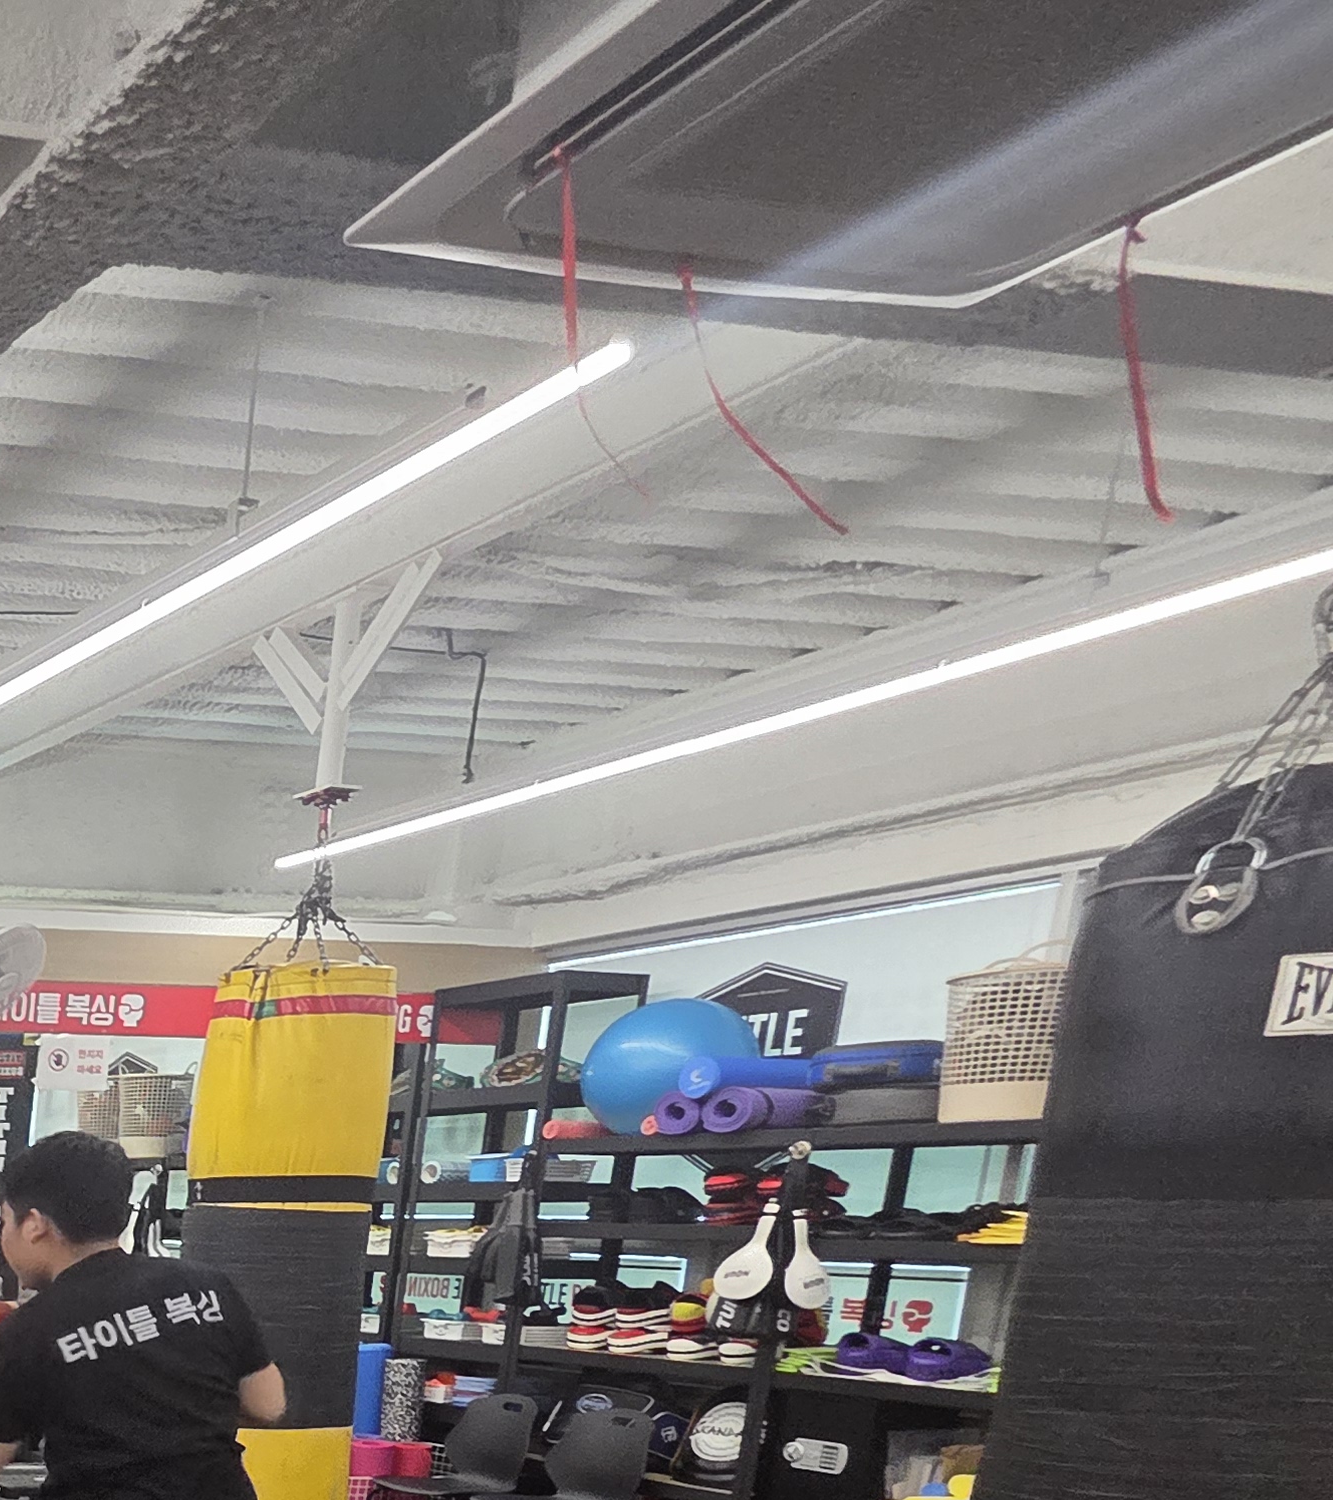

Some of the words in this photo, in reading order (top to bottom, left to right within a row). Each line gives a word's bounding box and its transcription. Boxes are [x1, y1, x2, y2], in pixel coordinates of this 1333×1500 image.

[65, 993, 116, 1026] 복싱
[1282, 961, 1333, 1026] EV
[742, 1008, 810, 1057] TLE
[541, 1283, 568, 1305] TLE
[56, 1304, 161, 1363] 타이틀
[164, 1289, 225, 1326] 복싱
